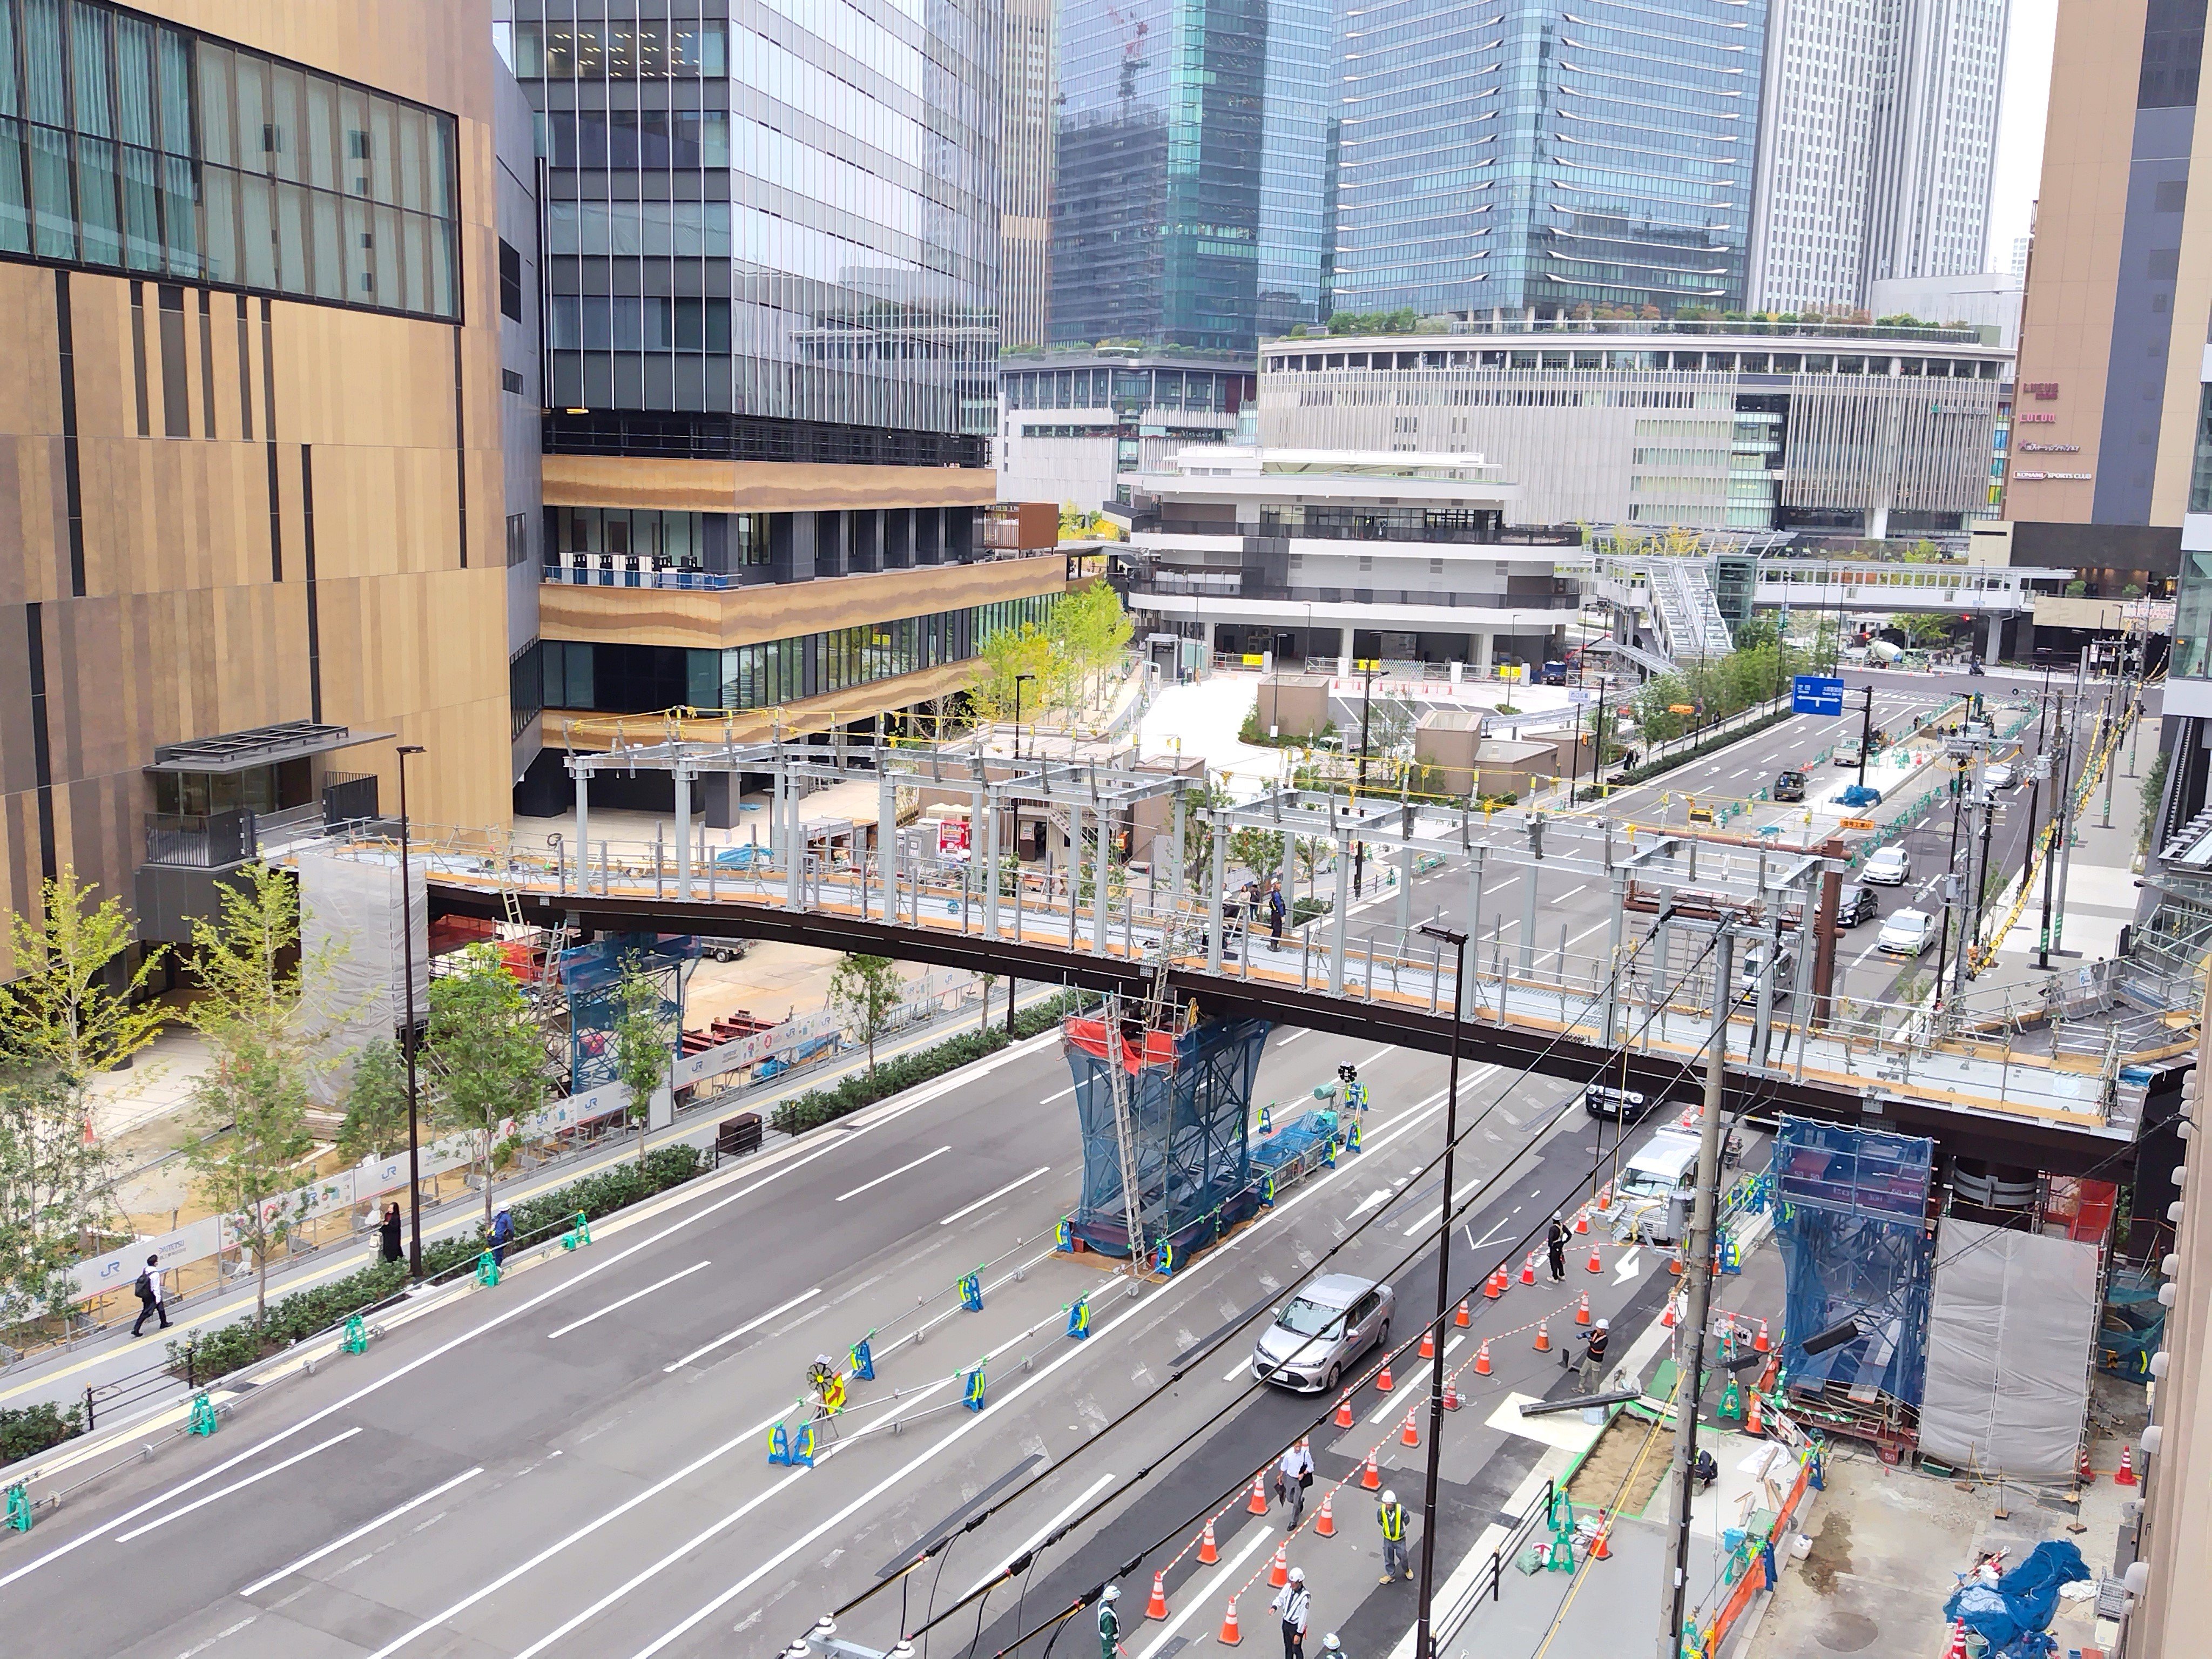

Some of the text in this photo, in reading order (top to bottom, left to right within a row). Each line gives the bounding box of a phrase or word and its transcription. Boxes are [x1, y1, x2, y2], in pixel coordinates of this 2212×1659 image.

[786, 1028, 795, 1037] JR
[692, 1061, 703, 1072] JR
[585, 1097, 597, 1109] JR
[382, 1165, 396, 1179] JR
[101, 1262, 120, 1277] JR
[1885, 1453, 1895, 1461] 50
